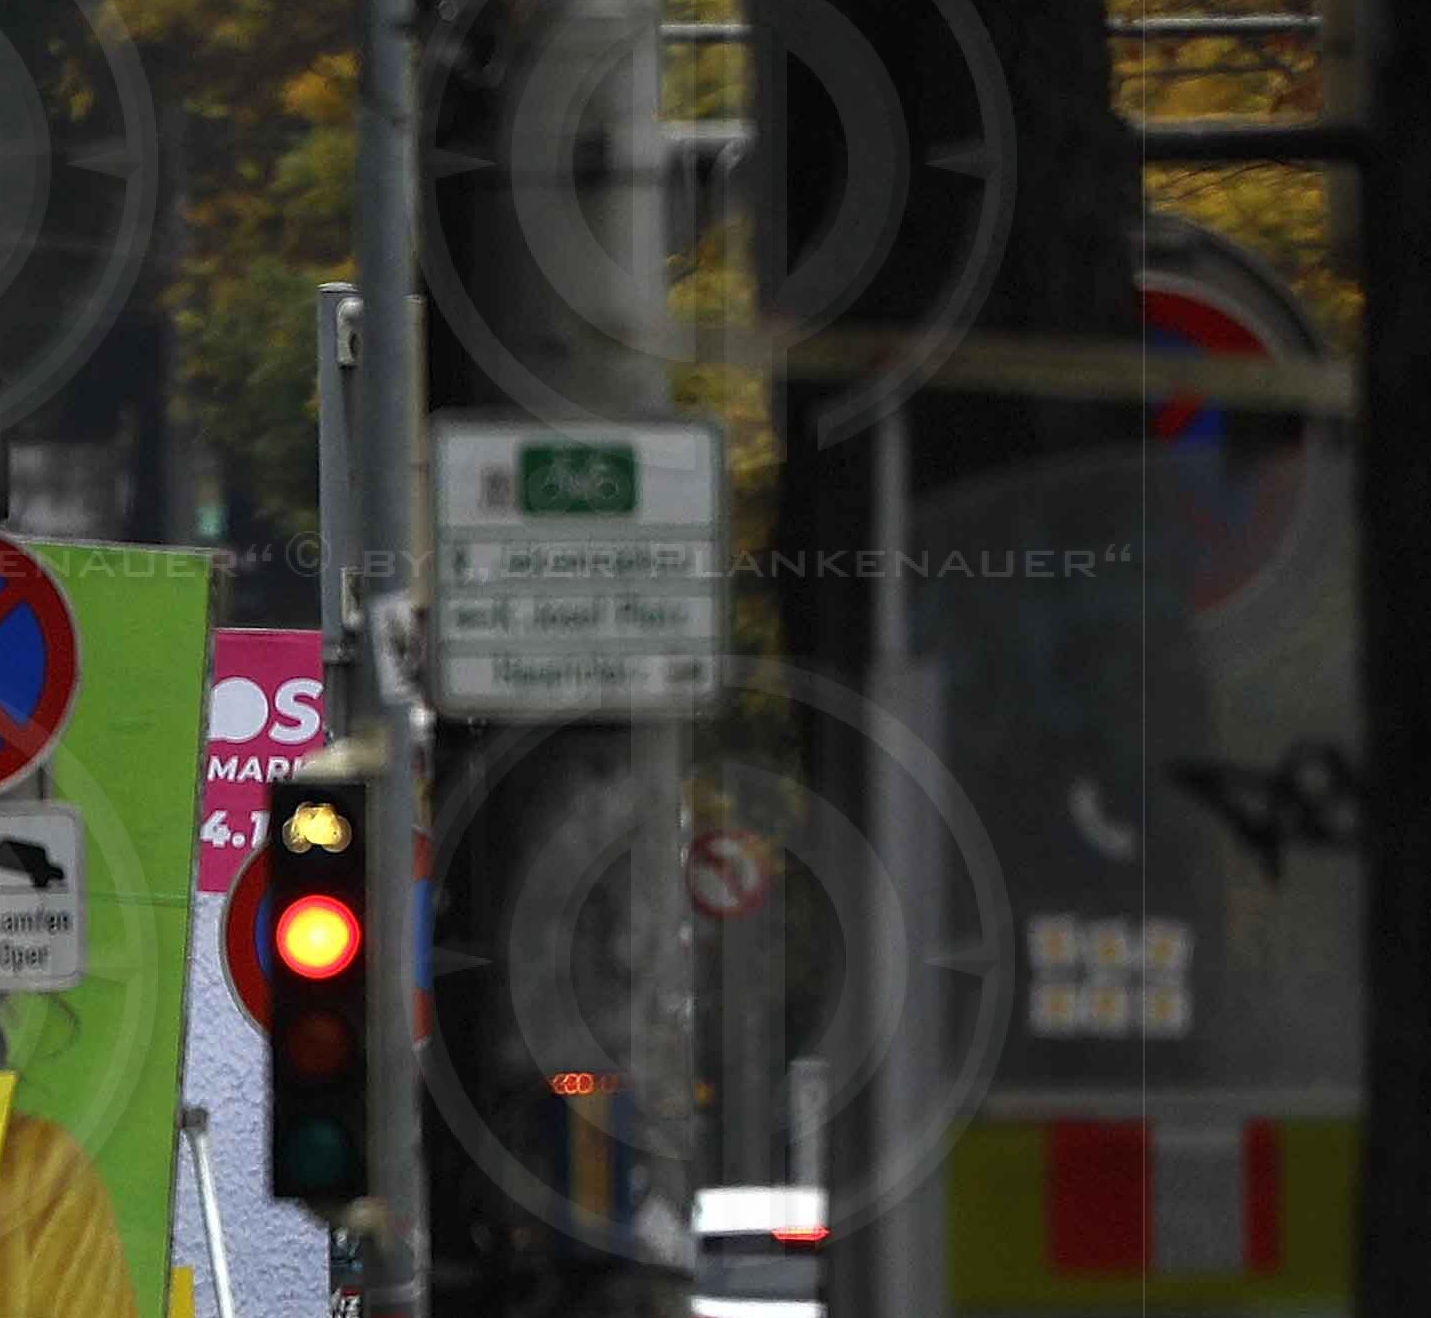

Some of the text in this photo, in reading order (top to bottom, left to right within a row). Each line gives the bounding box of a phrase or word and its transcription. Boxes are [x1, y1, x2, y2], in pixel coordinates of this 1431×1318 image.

[208, 677, 324, 745] OS
[207, 755, 313, 784] MAR
[200, 810, 271, 849] 4.1
